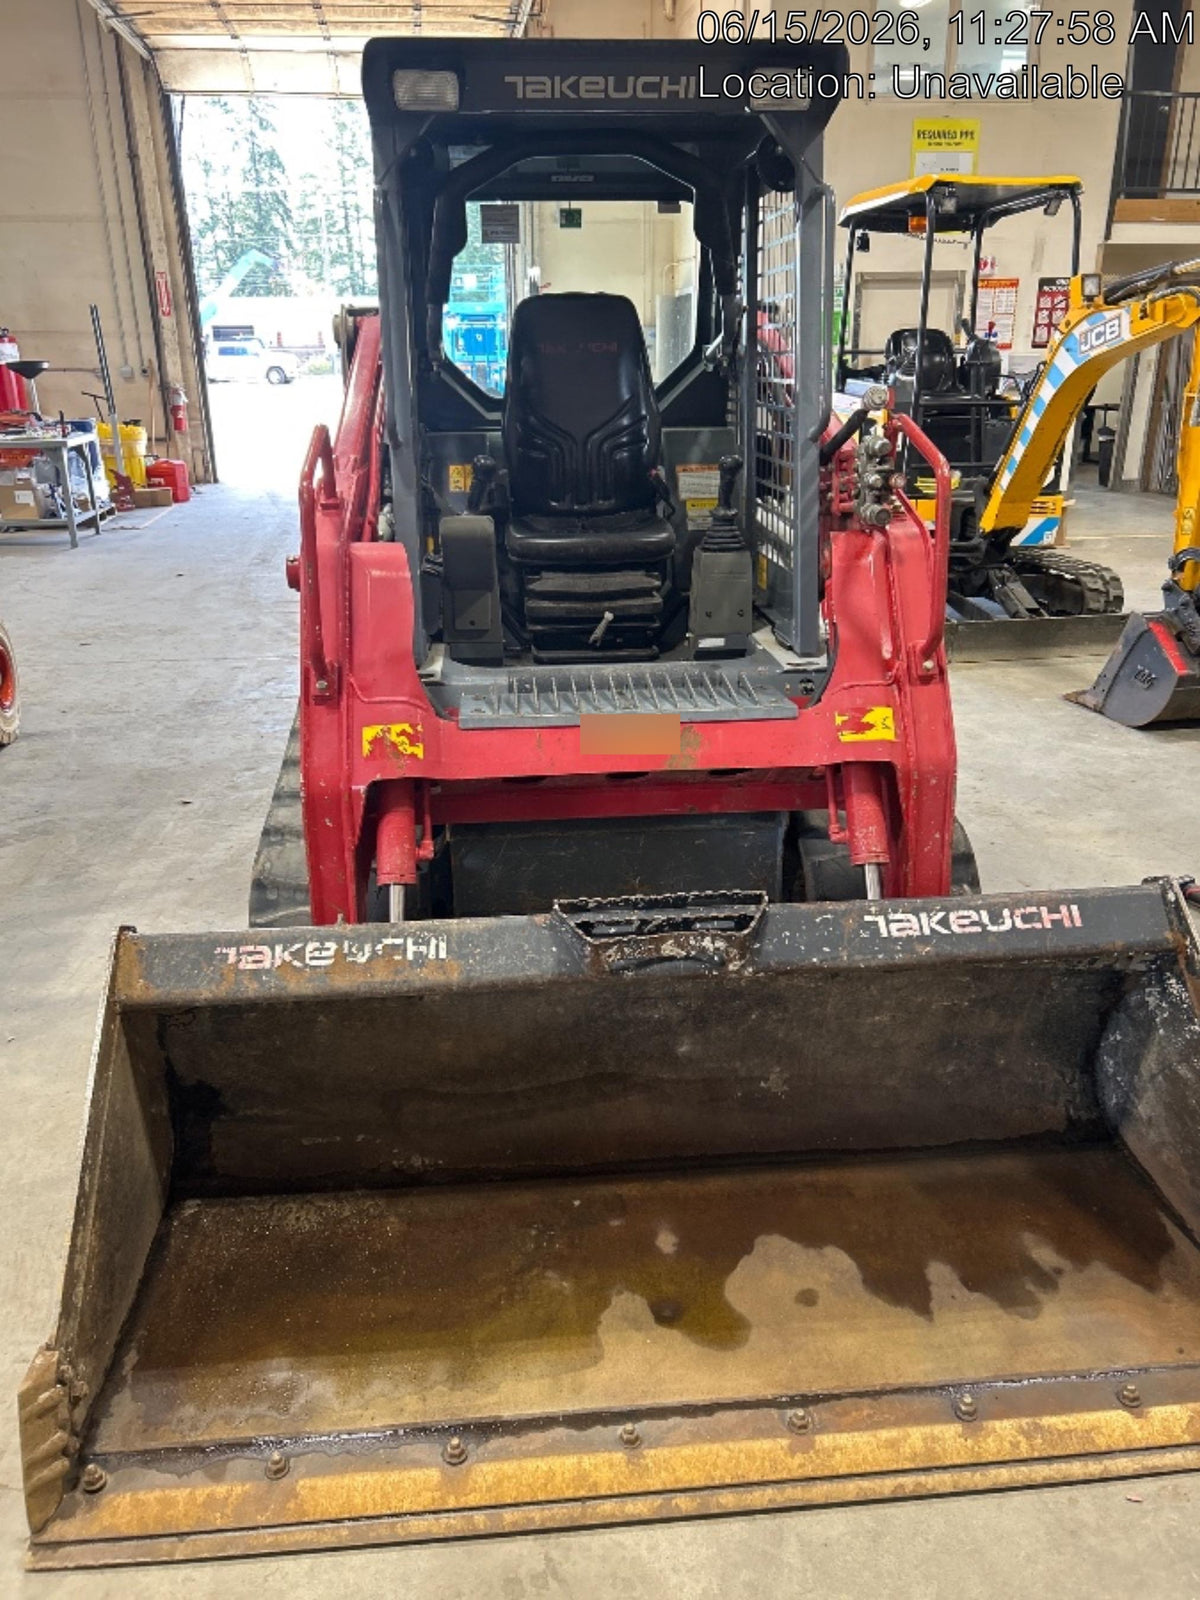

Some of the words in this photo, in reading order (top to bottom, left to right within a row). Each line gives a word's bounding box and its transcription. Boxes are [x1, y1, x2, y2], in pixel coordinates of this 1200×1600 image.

[504, 76, 696, 99] TAKEUCHI
[916, 129, 957, 140] REQUIRED
[1079, 317, 1120, 353] JCB
[862, 904, 1083, 938] TAKEUCHI
